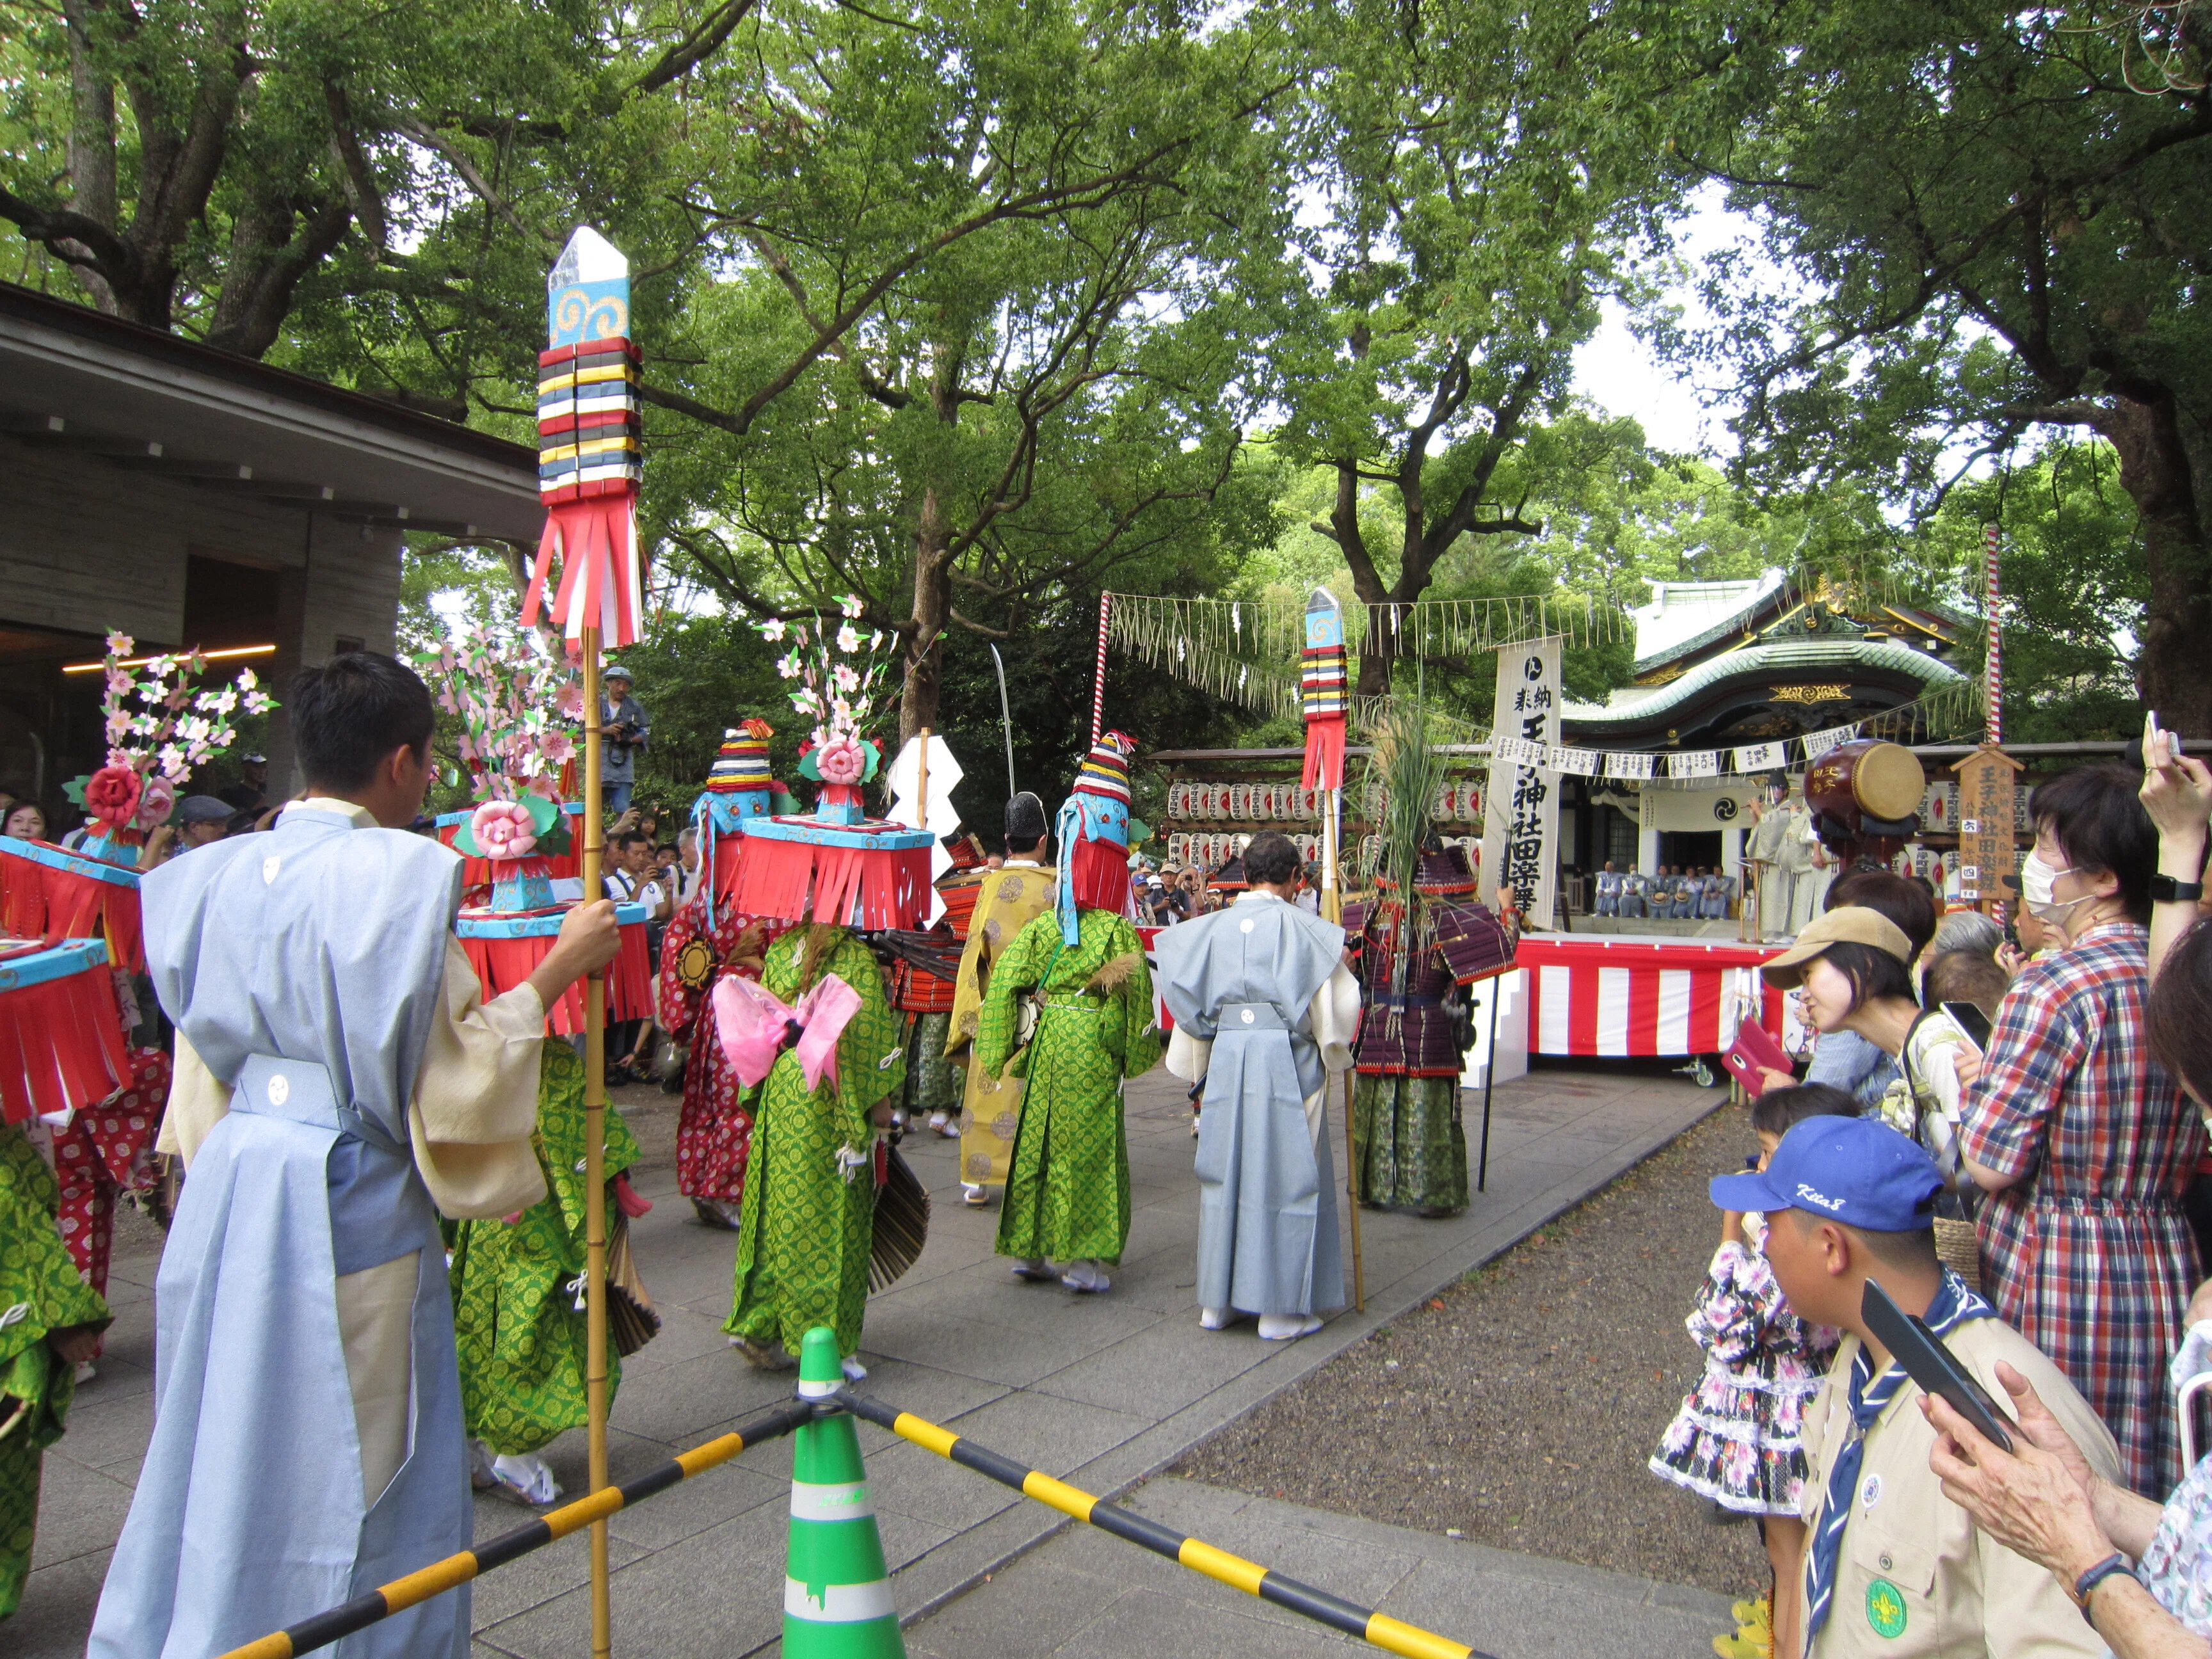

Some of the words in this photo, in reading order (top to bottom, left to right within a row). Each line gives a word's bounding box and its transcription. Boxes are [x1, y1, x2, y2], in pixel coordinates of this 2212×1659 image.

[1513, 685, 1551, 712] 奉納
[1761, 745, 1770, 760] 王子
[1822, 766, 1838, 794] 王子
[1797, 1184, 1846, 1210] Kita8
